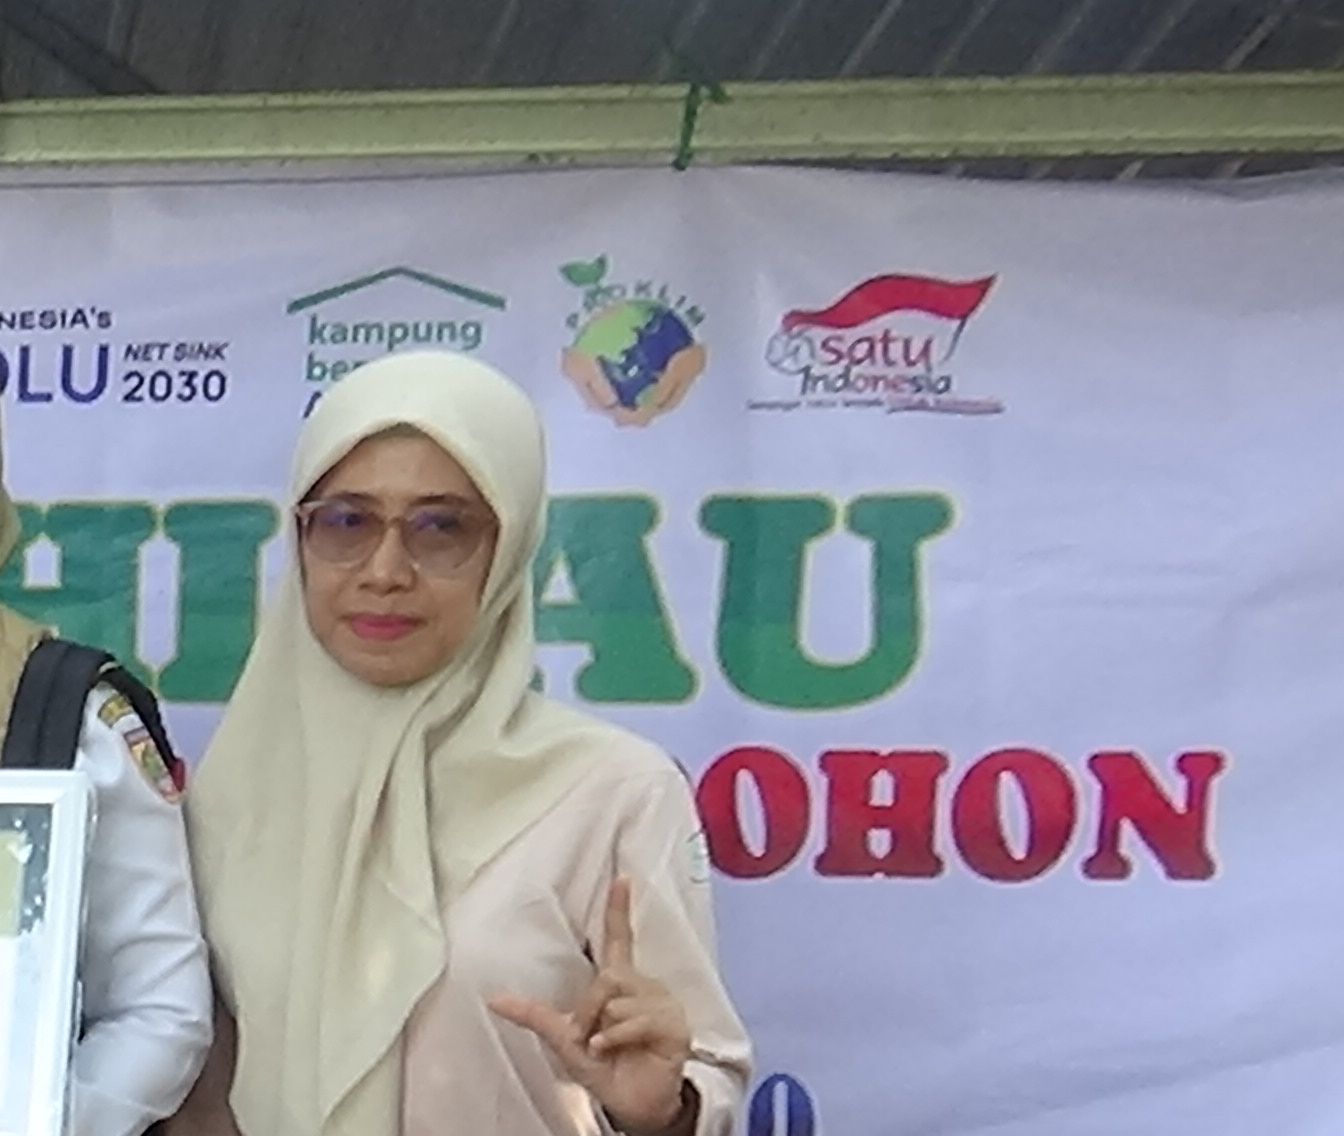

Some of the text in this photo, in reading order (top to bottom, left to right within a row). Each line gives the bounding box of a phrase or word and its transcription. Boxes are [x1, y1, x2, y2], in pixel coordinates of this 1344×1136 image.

[309, 314, 482, 351] kampung
[123, 341, 229, 362] NET SINK
[820, 329, 934, 373] satu
[121, 369, 227, 403] 2030
[799, 364, 952, 396] Indonesia
[696, 745, 1226, 882] OHON
